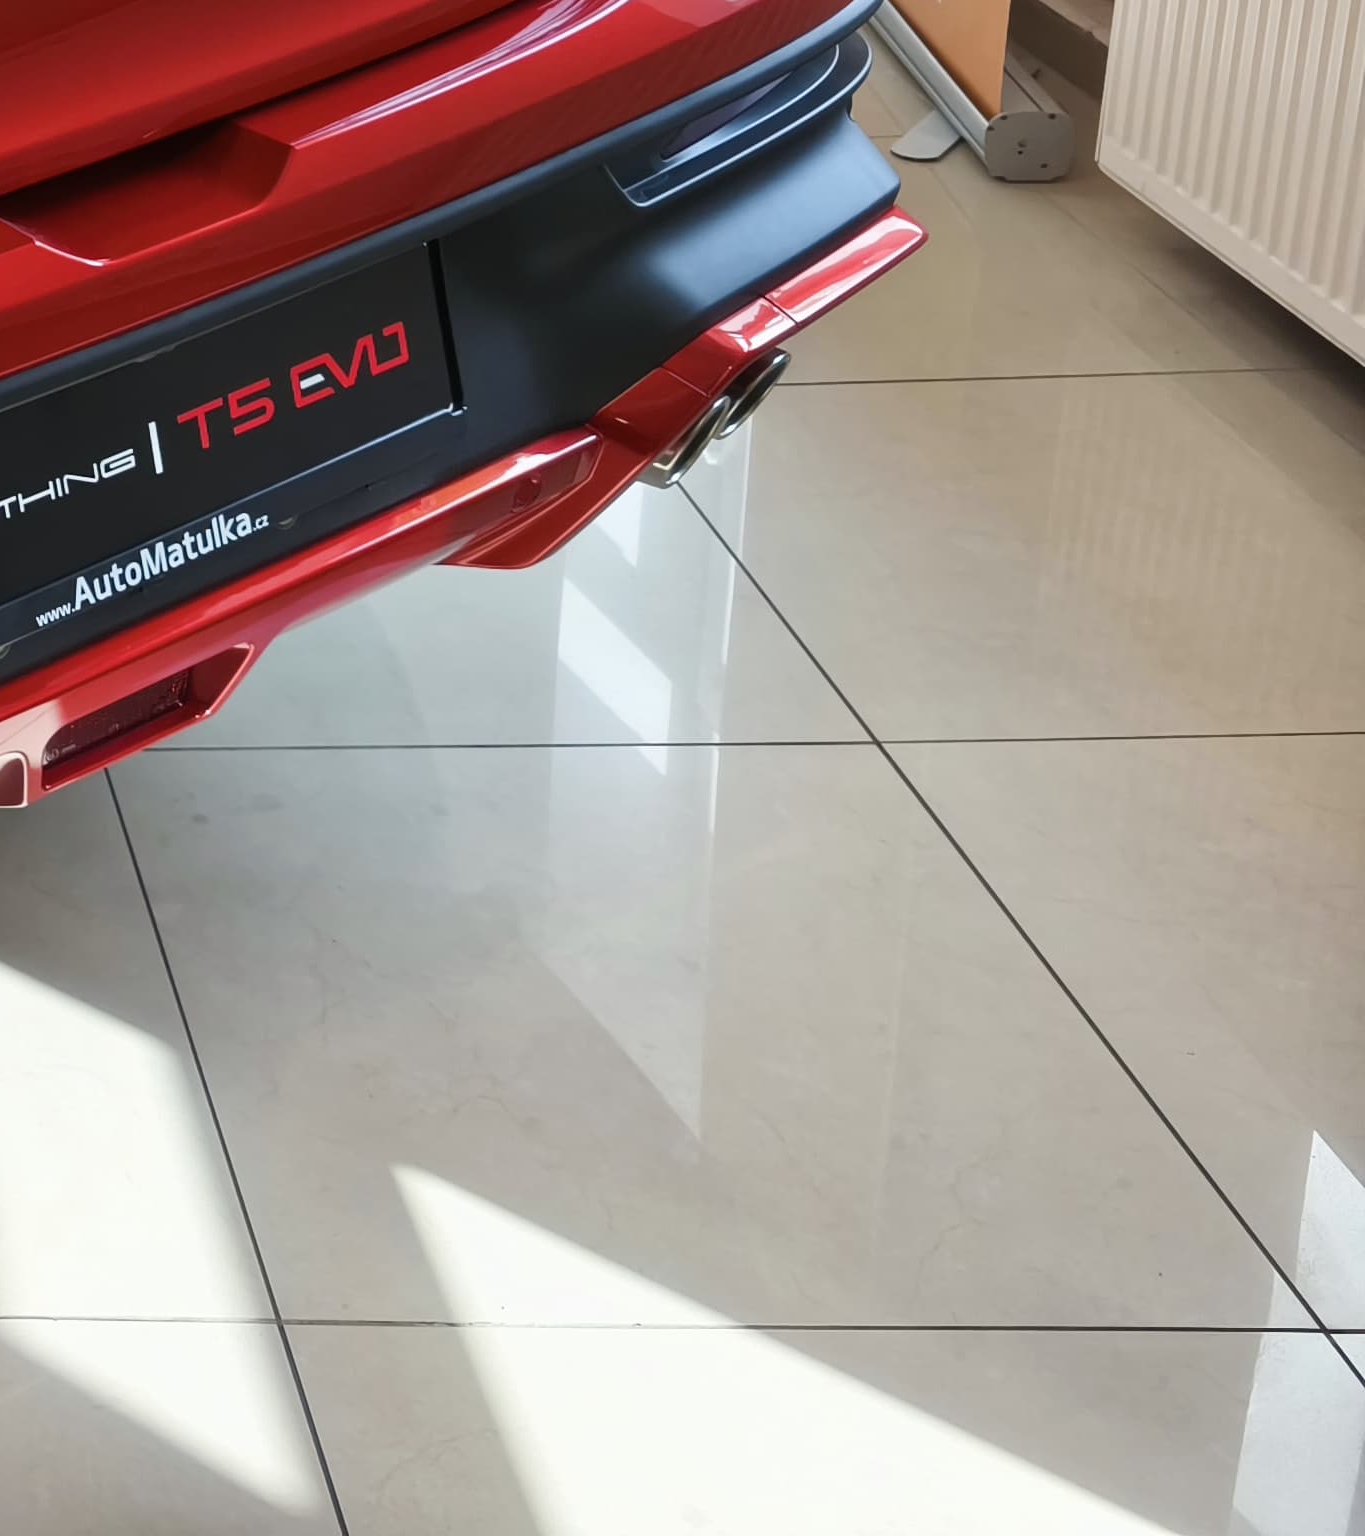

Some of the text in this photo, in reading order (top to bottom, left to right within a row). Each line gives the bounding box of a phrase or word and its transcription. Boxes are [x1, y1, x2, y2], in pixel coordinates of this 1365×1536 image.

[176, 377, 276, 449] T5
[290, 321, 409, 408] EVO
[35, 512, 269, 627] www.AutoMatulka.cz
